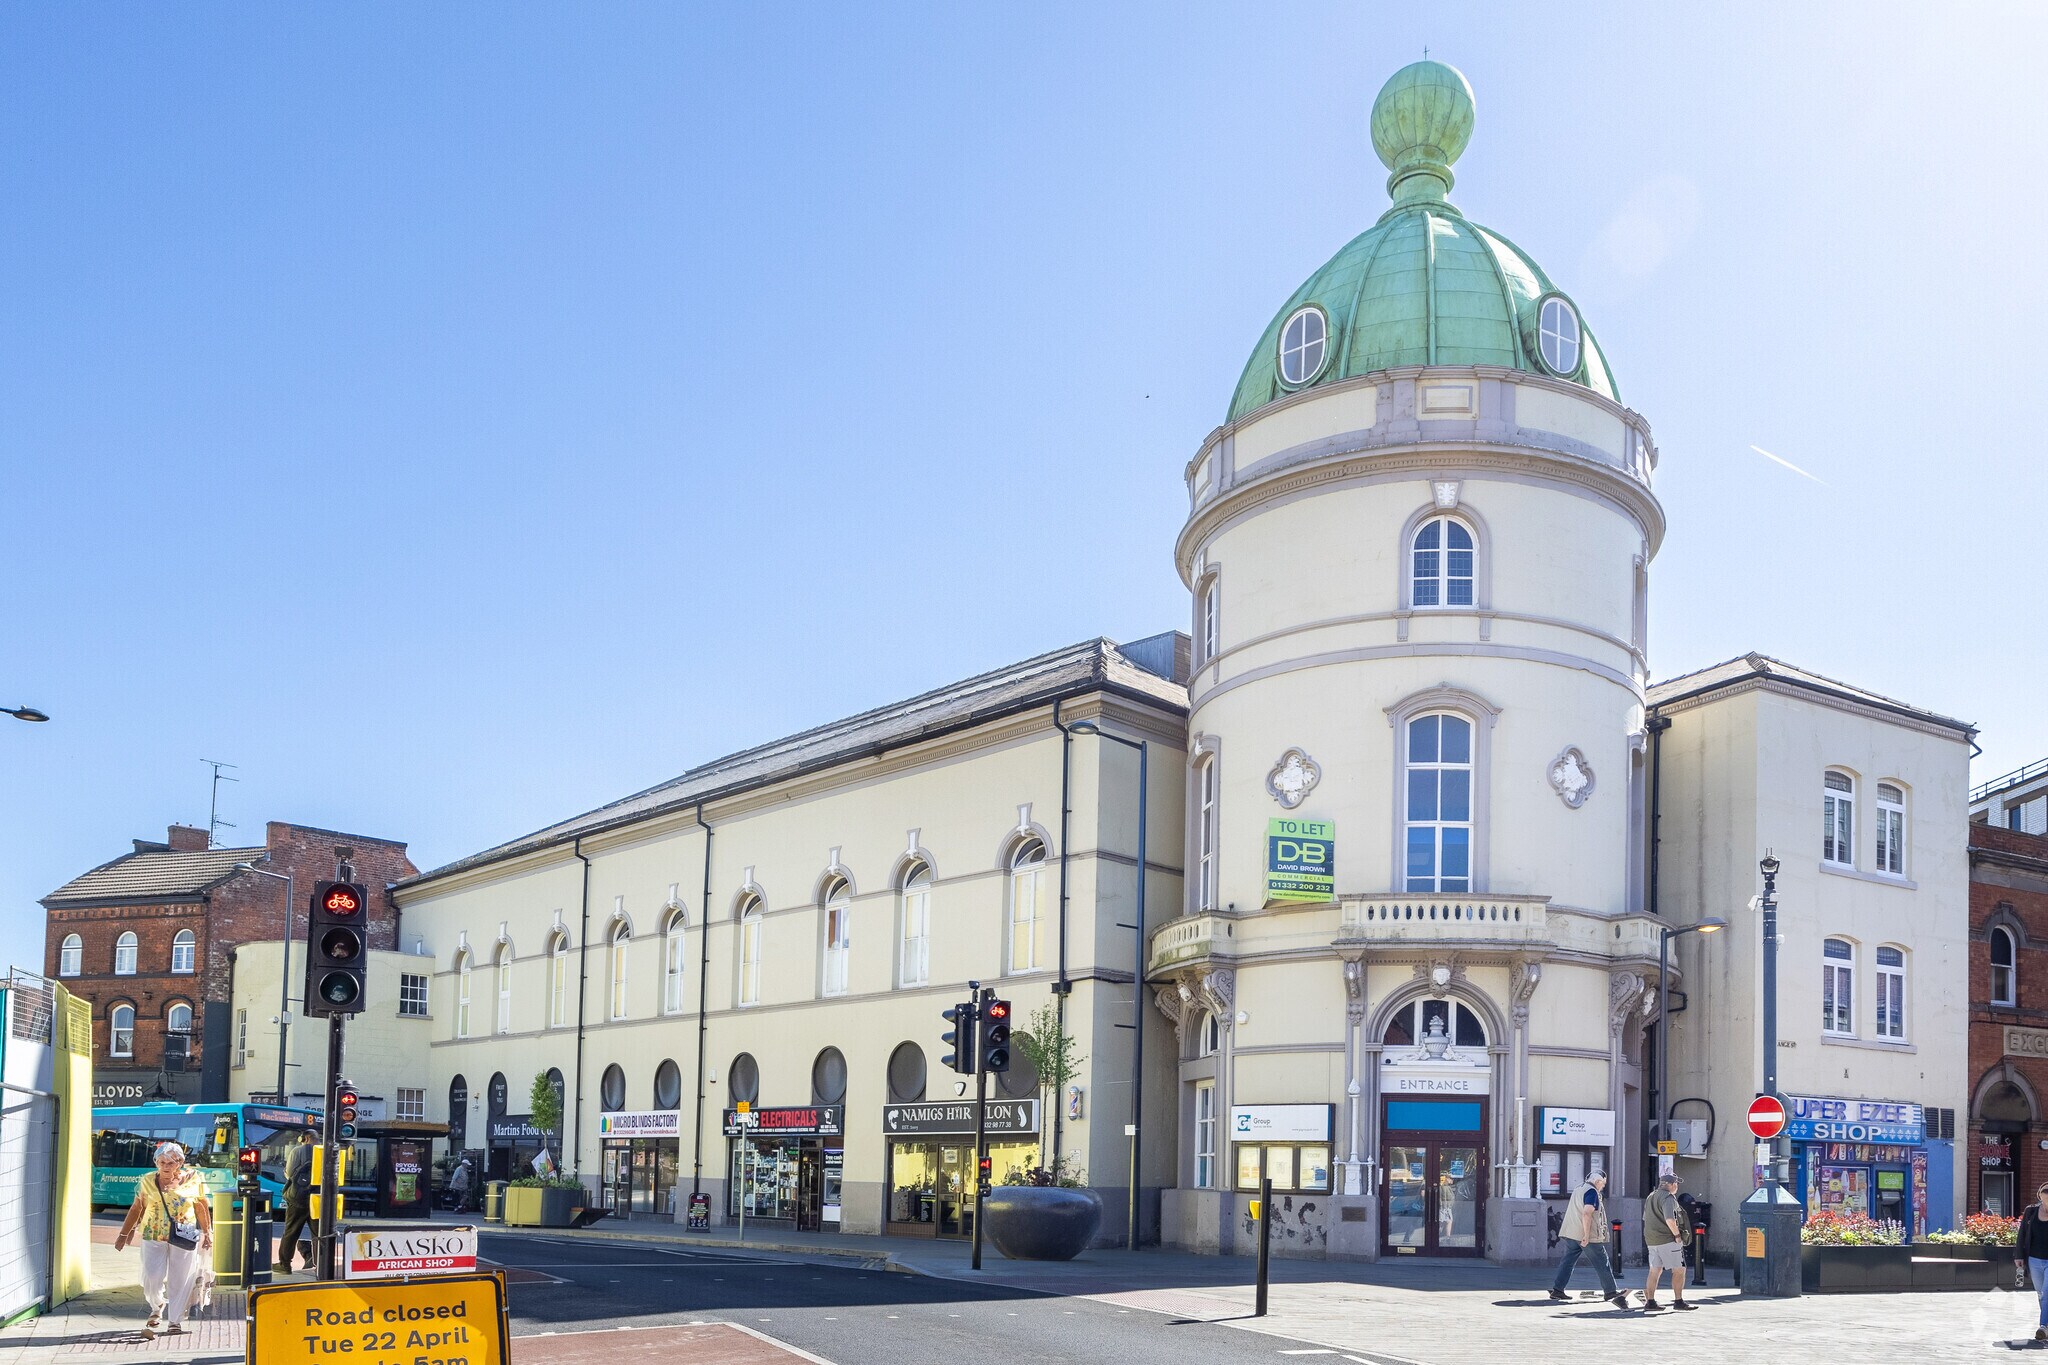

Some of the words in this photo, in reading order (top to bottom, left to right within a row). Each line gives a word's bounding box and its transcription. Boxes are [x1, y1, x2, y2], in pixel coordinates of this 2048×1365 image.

[1279, 821, 1297, 833] TO
[1302, 823, 1325, 835] LET
[1277, 873, 1325, 882] COMMERCIAL
[92, 1085, 143, 1098] LLOYDS
[1400, 1080, 1469, 1091] ENTRANCE
[901, 1107, 944, 1121] NAMIGS
[985, 1105, 1012, 1119] LON
[1793, 1098, 1847, 1120] UPER
[1858, 1102, 1907, 1125] EZEE
[261, 1112, 303, 1124] Mackworth
[307, 1114, 314, 1125] 8
[613, 1115, 631, 1128] MICRO
[632, 1115, 652, 1128] BLINDS
[653, 1114, 678, 1128] FACTORY
[747, 1112, 759, 1128] SC
[760, 1110, 817, 1127] ELECTRICALS
[1253, 1117, 1271, 1125] Group
[1568, 1120, 1586, 1129] Group
[493, 1123, 520, 1136] Martins
[521, 1123, 539, 1136] Food
[1814, 1123, 1881, 1141] SHOP
[1985, 1135, 1998, 1144] THE
[1980, 1144, 2010, 1158] HOME
[1981, 1157, 2001, 1166] SHOP
[368, 1236, 464, 1258] BAASKO
[377, 1260, 423, 1270] AFRICAN
[425, 1259, 454, 1267] SHOP
[305, 1306, 374, 1326] Road
[383, 1300, 466, 1323] closed
[303, 1335, 354, 1354] Tue
[363, 1331, 396, 1352] 22
[406, 1326, 469, 1350] April
